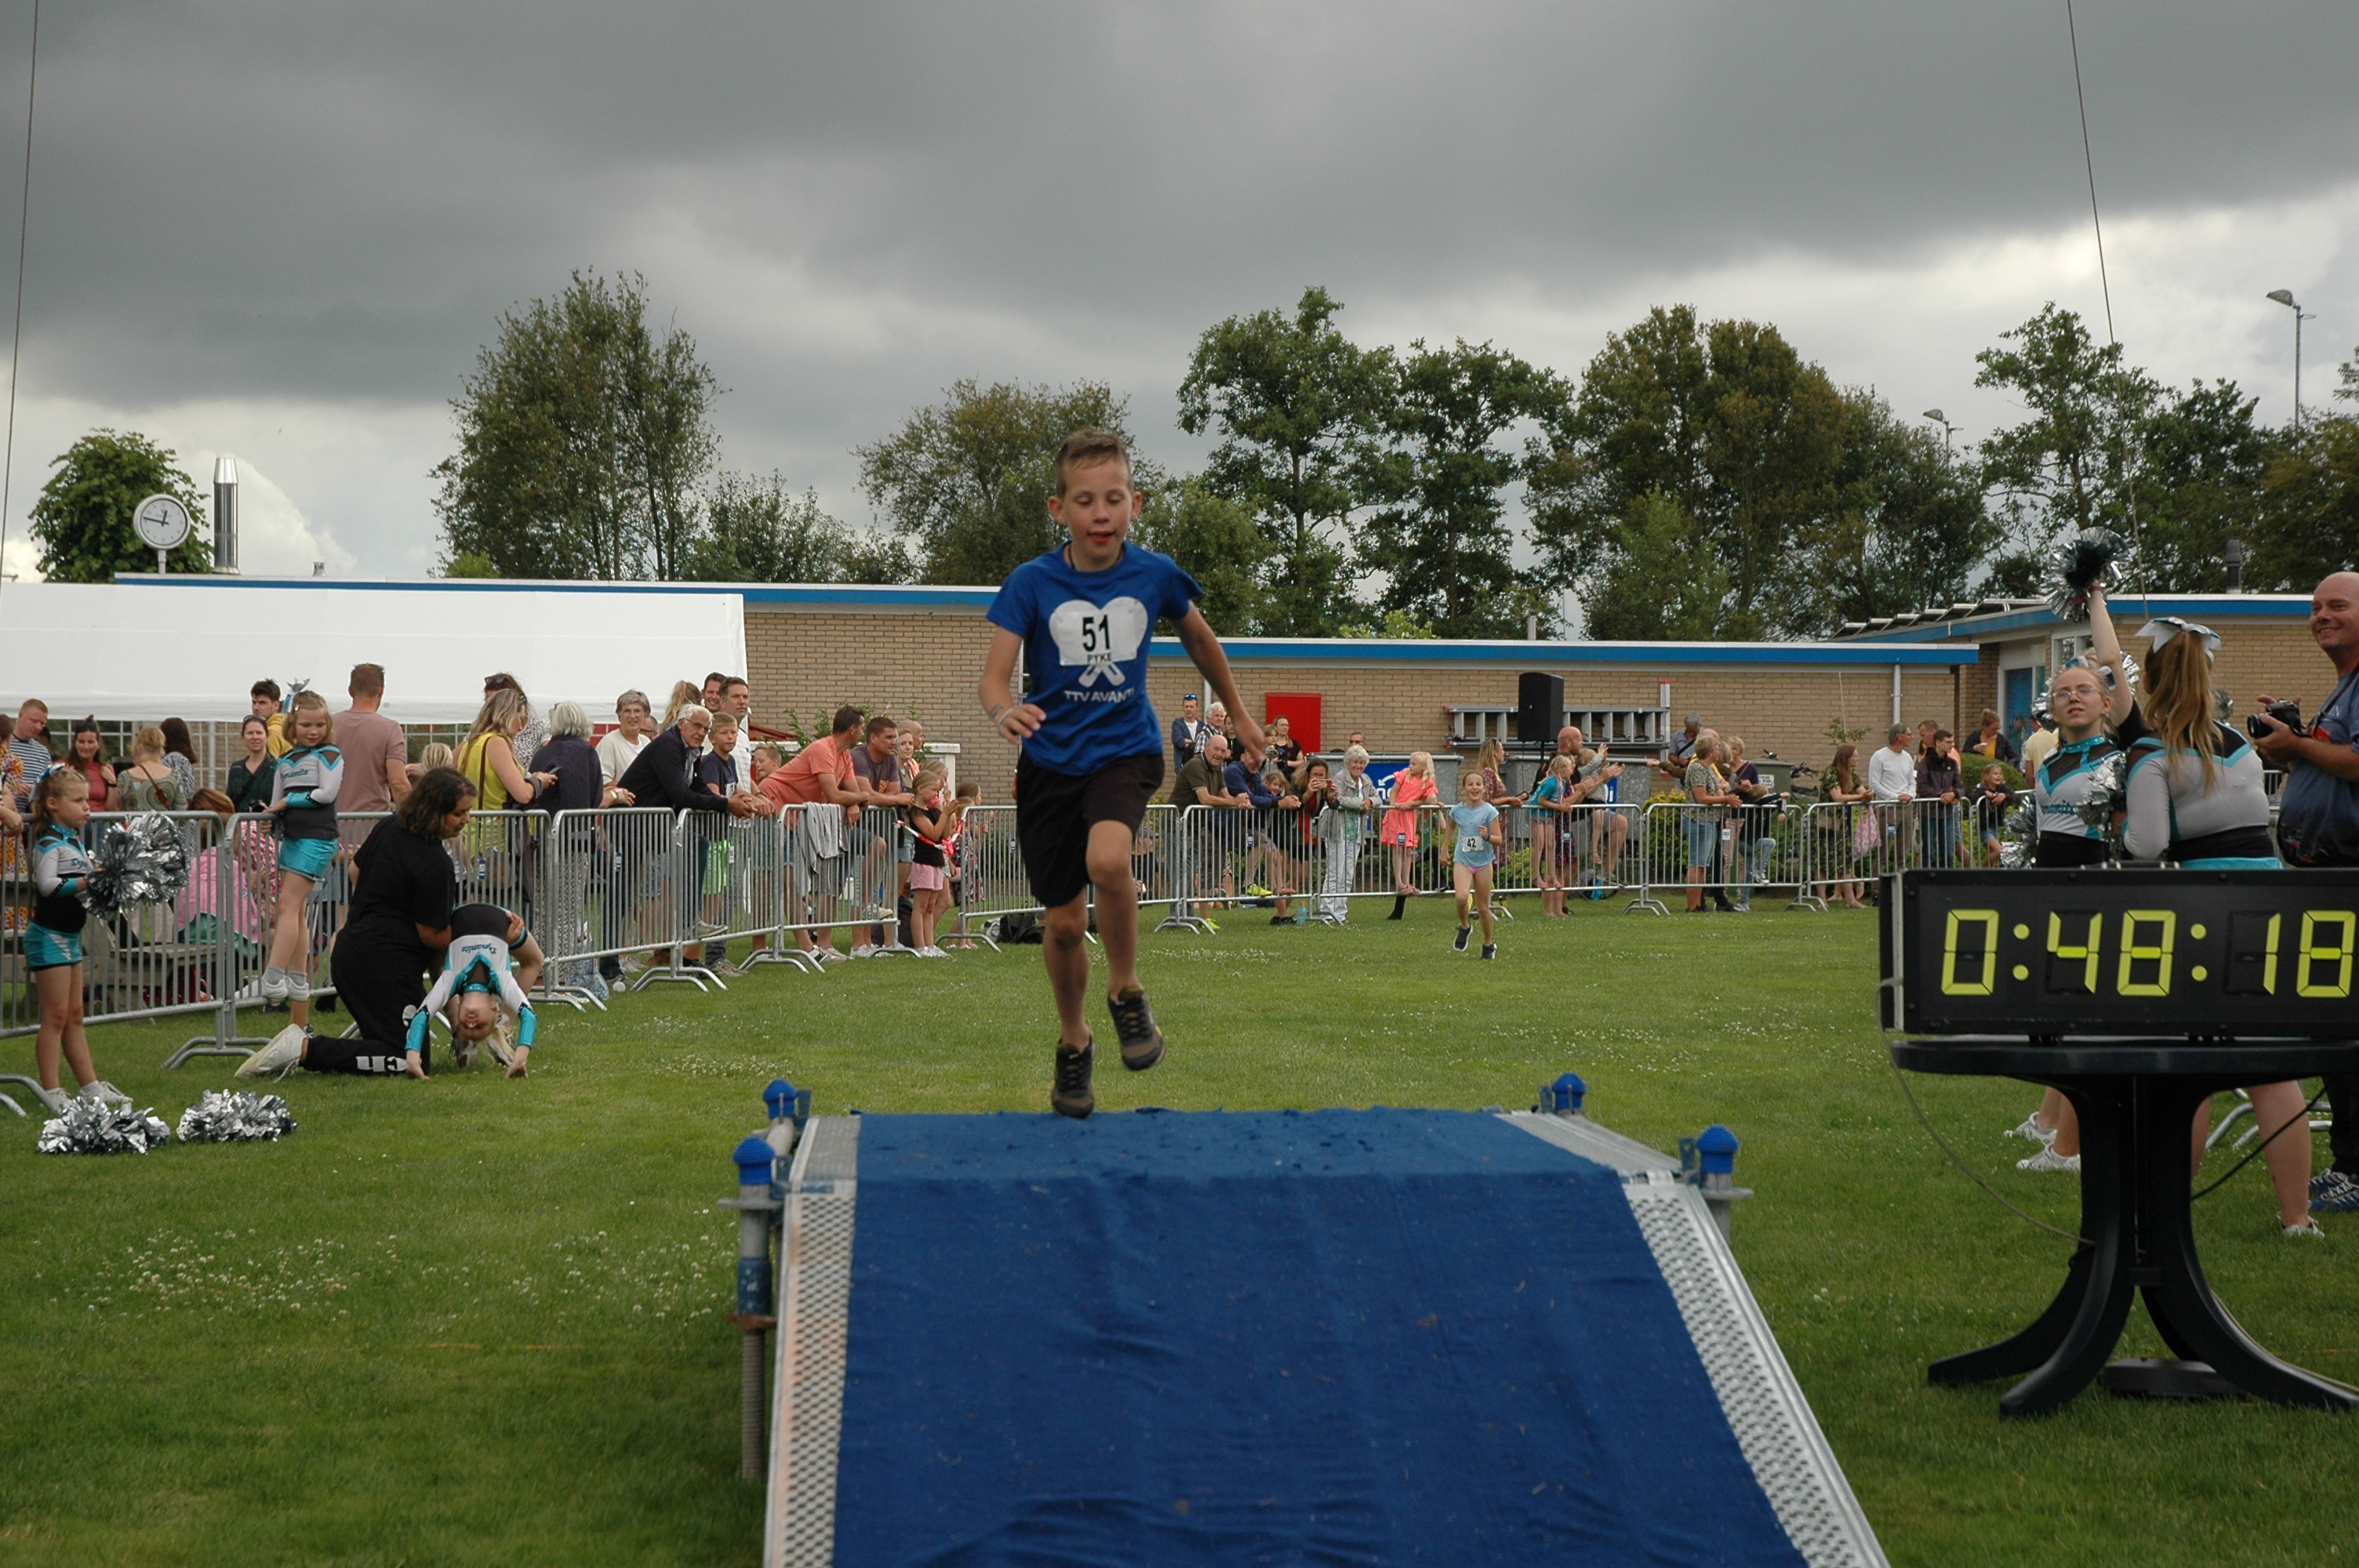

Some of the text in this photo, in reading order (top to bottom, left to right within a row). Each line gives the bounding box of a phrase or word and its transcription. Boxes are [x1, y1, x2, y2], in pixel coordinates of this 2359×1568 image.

[1082, 615, 1110, 652] 51
[1063, 690, 1090, 702] TTV
[1467, 838, 1477, 848] 42
[1941, 909, 2357, 997] 0:48:18
